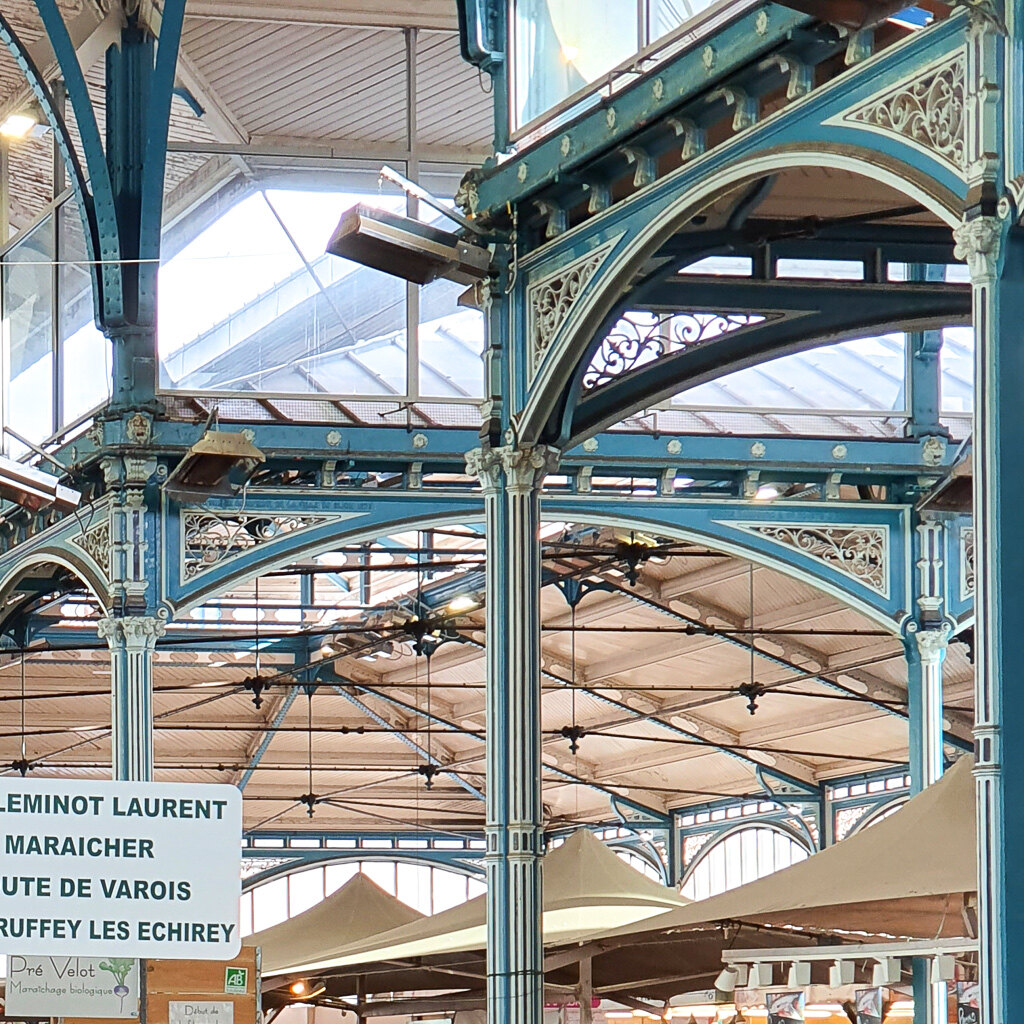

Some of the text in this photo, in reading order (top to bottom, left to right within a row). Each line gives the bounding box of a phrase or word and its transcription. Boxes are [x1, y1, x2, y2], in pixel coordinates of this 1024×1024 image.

[113, 797, 227, 819] LAURENT
[5, 835, 155, 858] MARAICHER
[60, 878, 92, 898] DE
[100, 879, 192, 900] VAROIS
[89, 920, 130, 941] LES
[138, 922, 236, 943] ECHIREY
[11, 955, 96, 979] Pré Velot
[70, 983, 113, 996] biologique
[228, 974, 243, 986] AB
